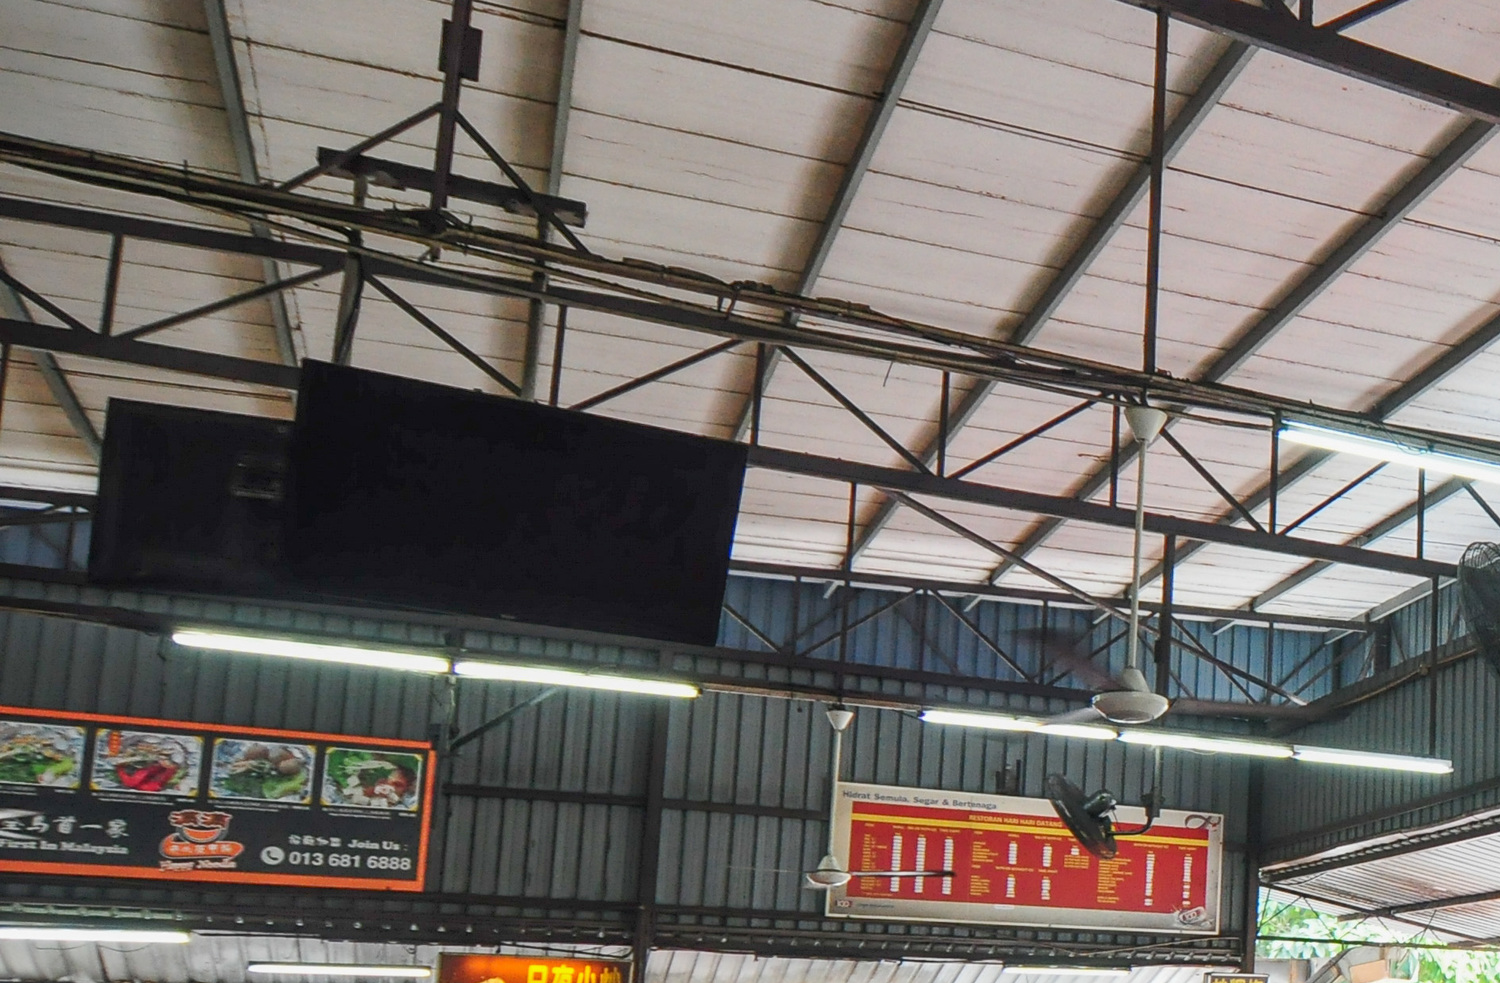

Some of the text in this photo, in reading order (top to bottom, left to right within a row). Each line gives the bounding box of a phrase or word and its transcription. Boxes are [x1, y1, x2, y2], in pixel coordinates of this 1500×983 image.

[952, 798, 997, 811] Bertenaga
[968, 814, 1003, 824] RESTORAN
[1004, 817, 1019, 825] HARI
[1020, 818, 1035, 826] HARI
[59, 842, 130, 855] Malaysia
[347, 839, 380, 850] Join
[382, 840, 400, 851] Us
[288, 851, 412, 870] 013 681 6888
